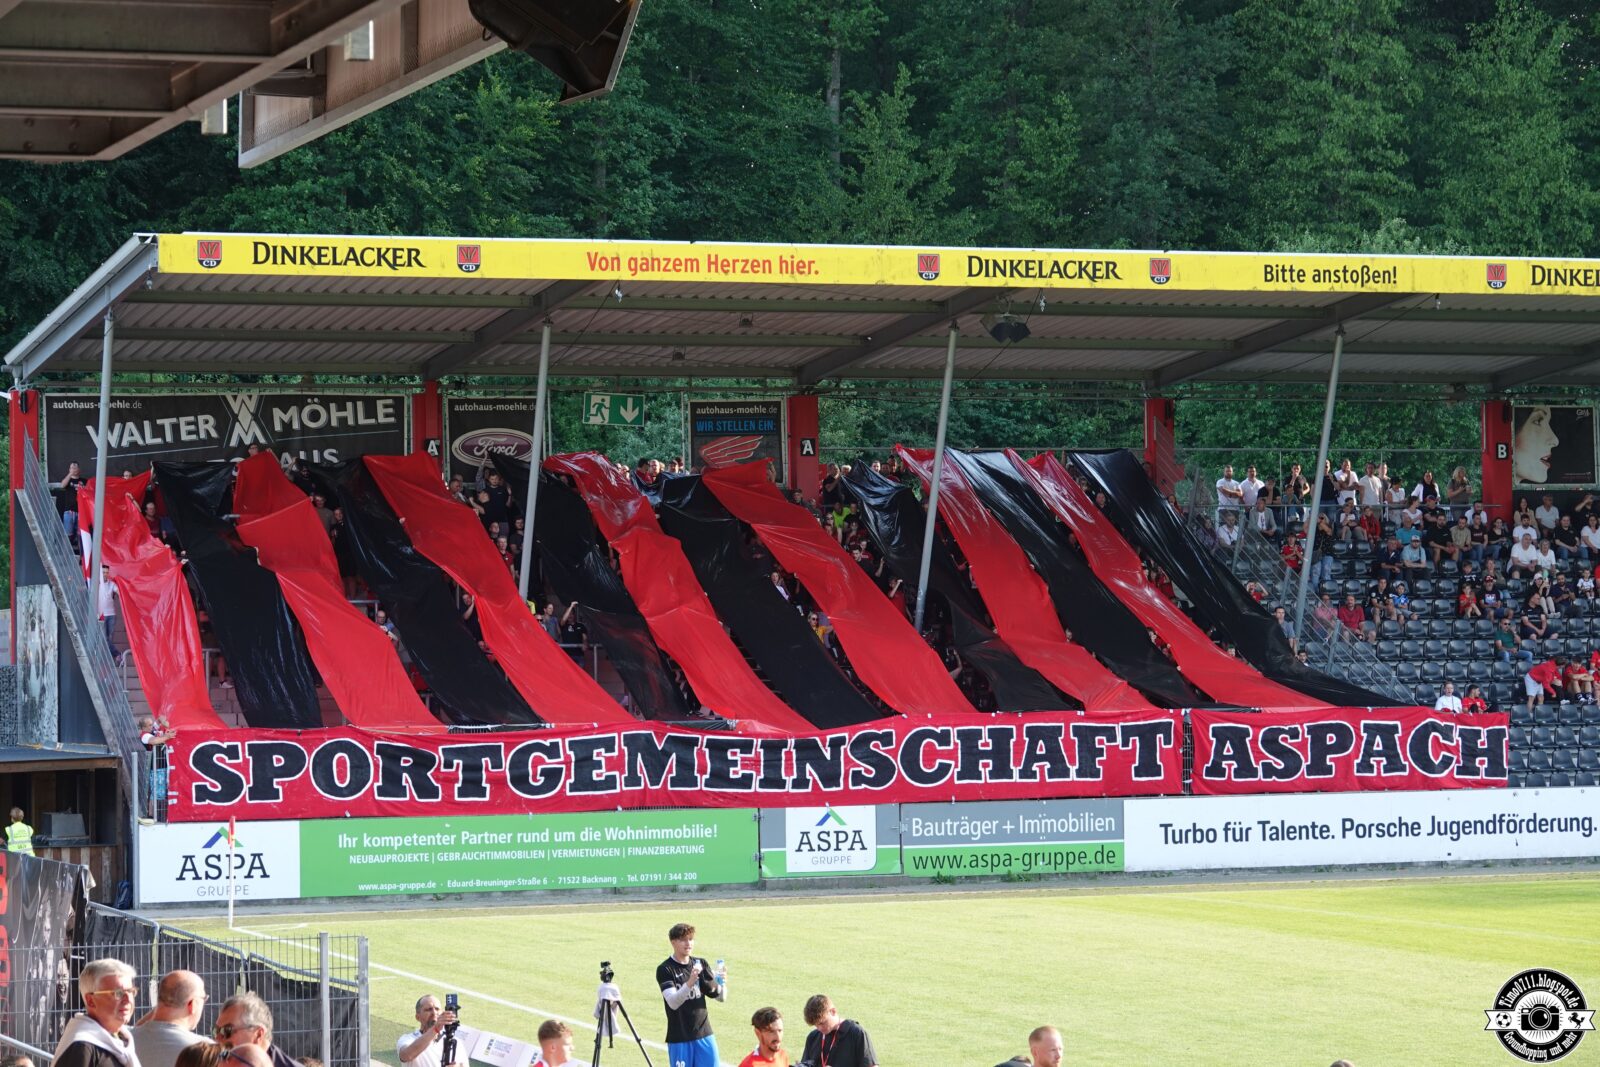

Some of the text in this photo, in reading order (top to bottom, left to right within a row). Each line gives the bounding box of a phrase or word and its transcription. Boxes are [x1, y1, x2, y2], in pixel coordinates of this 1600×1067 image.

[251, 241, 427, 271] DINKELACKER
[586, 251, 820, 276] Von ganzem Herzen hier.
[922, 272, 936, 280] CD
[967, 255, 1124, 282] DINKELACKER
[1263, 264, 1398, 288] Bitte anstoßen!
[52, 400, 142, 410] autohaus-ehle.de
[86, 398, 397, 449] WALTER MÖHLE
[696, 420, 777, 432] WIR STELLEN EIN:
[427, 440, 438, 455] A
[802, 440, 814, 454] A
[1498, 444, 1507, 458] B
[191, 719, 1174, 804] SPORTGEMEINSCHAFT
[1203, 719, 1509, 781] ASPACH
[338, 824, 718, 850] Ihr kompetenter Partner rund um die Wohnimmobilie!
[912, 813, 1116, 840] Bauträger + Immobilien
[1159, 813, 1598, 845] Turbo für Talente. Porsche Jugendförderung.
[795, 830, 867, 852] ASPA
[175, 853, 270, 881] ASPA
[349, 853, 430, 865] NEUBAUPROJEKTE
[551, 847, 620, 859] VERMIETUNGEN
[628, 845, 705, 856] FINANZBERATUNG
[811, 856, 852, 865] GRUPPE
[913, 845, 1116, 872] www.aspa-gruppe.de
[358, 881, 436, 891] www.aspa-gruppe.de
[447, 878, 541, 888] Eduard-Breuninger-Straße
[542, 877, 548, 885] 6
[558, 876, 580, 885] 71522
[582, 875, 617, 885] Backnang
[627, 874, 639, 882] Tel.
[640, 874, 662, 882] 07191
[668, 873, 682, 881] 344
[684, 872, 697, 880] 200
